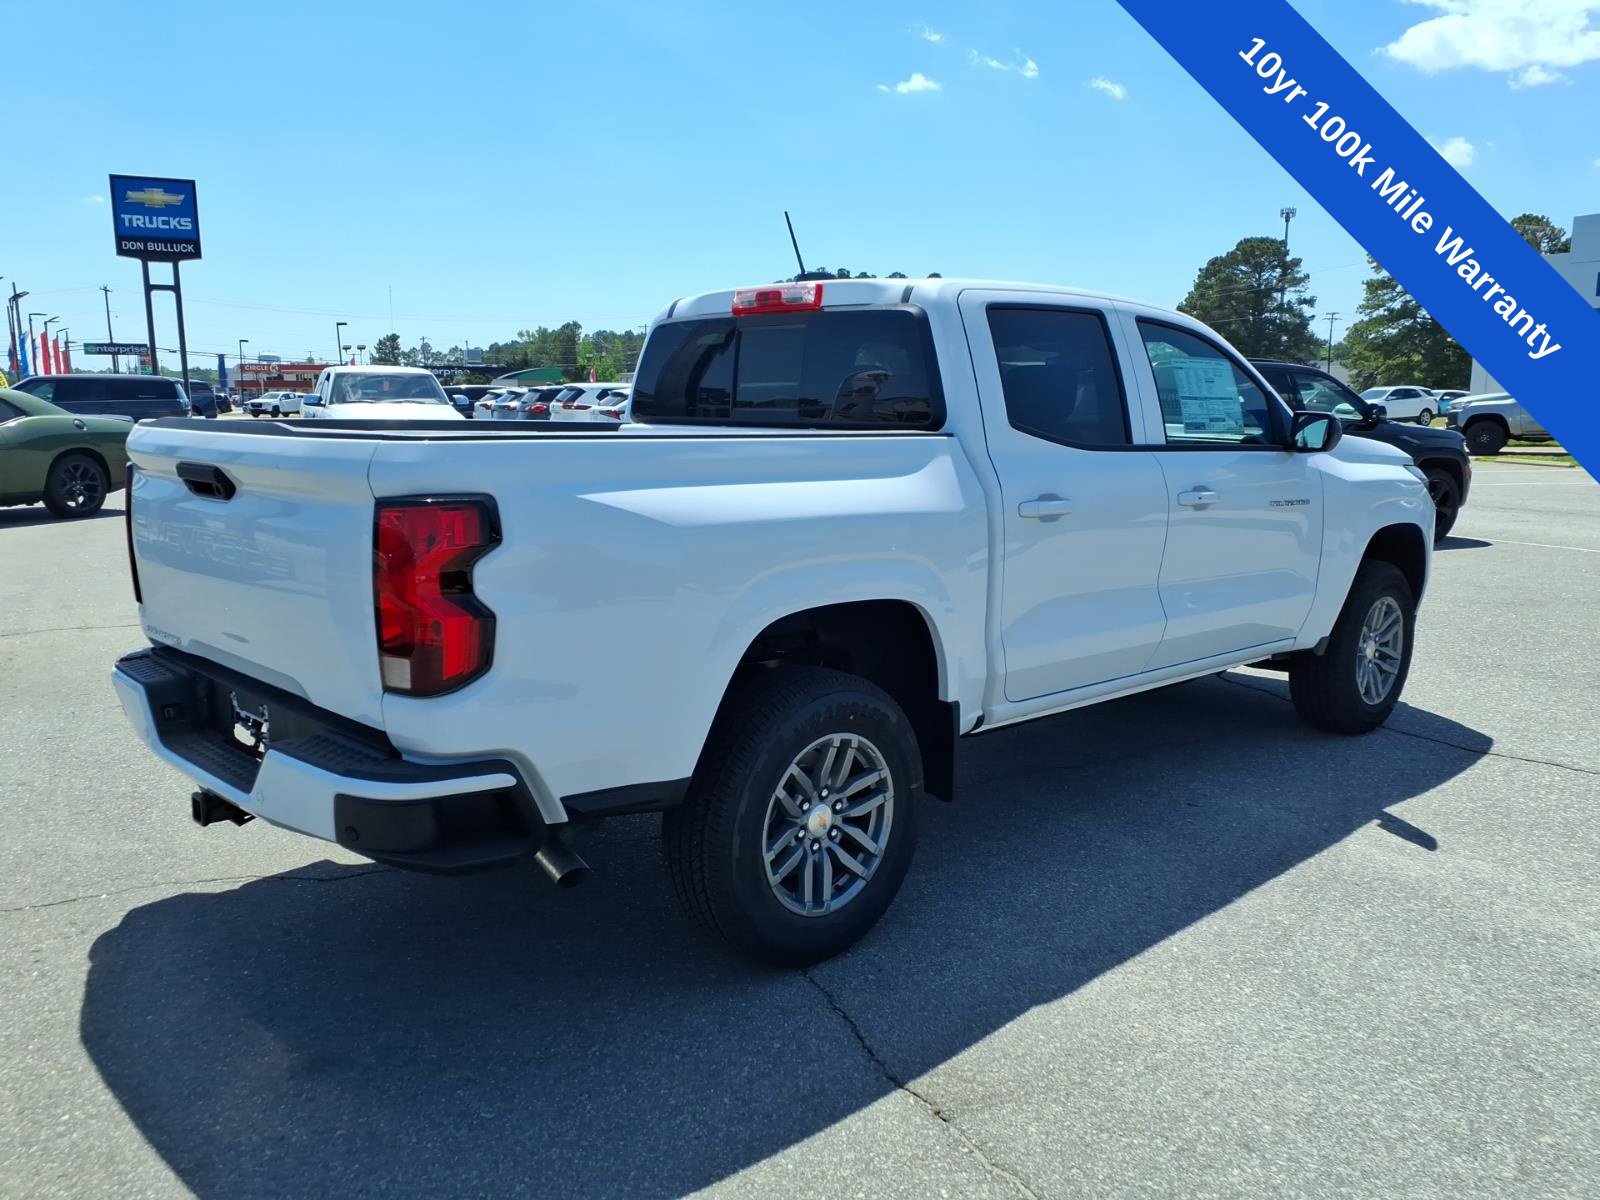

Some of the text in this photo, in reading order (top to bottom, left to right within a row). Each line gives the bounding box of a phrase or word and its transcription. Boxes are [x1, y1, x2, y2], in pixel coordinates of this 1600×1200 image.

[120, 214, 192, 230] TRUCKS
[121, 241, 195, 253] DON BULLUCK
[86, 345, 148, 354] enterprise
